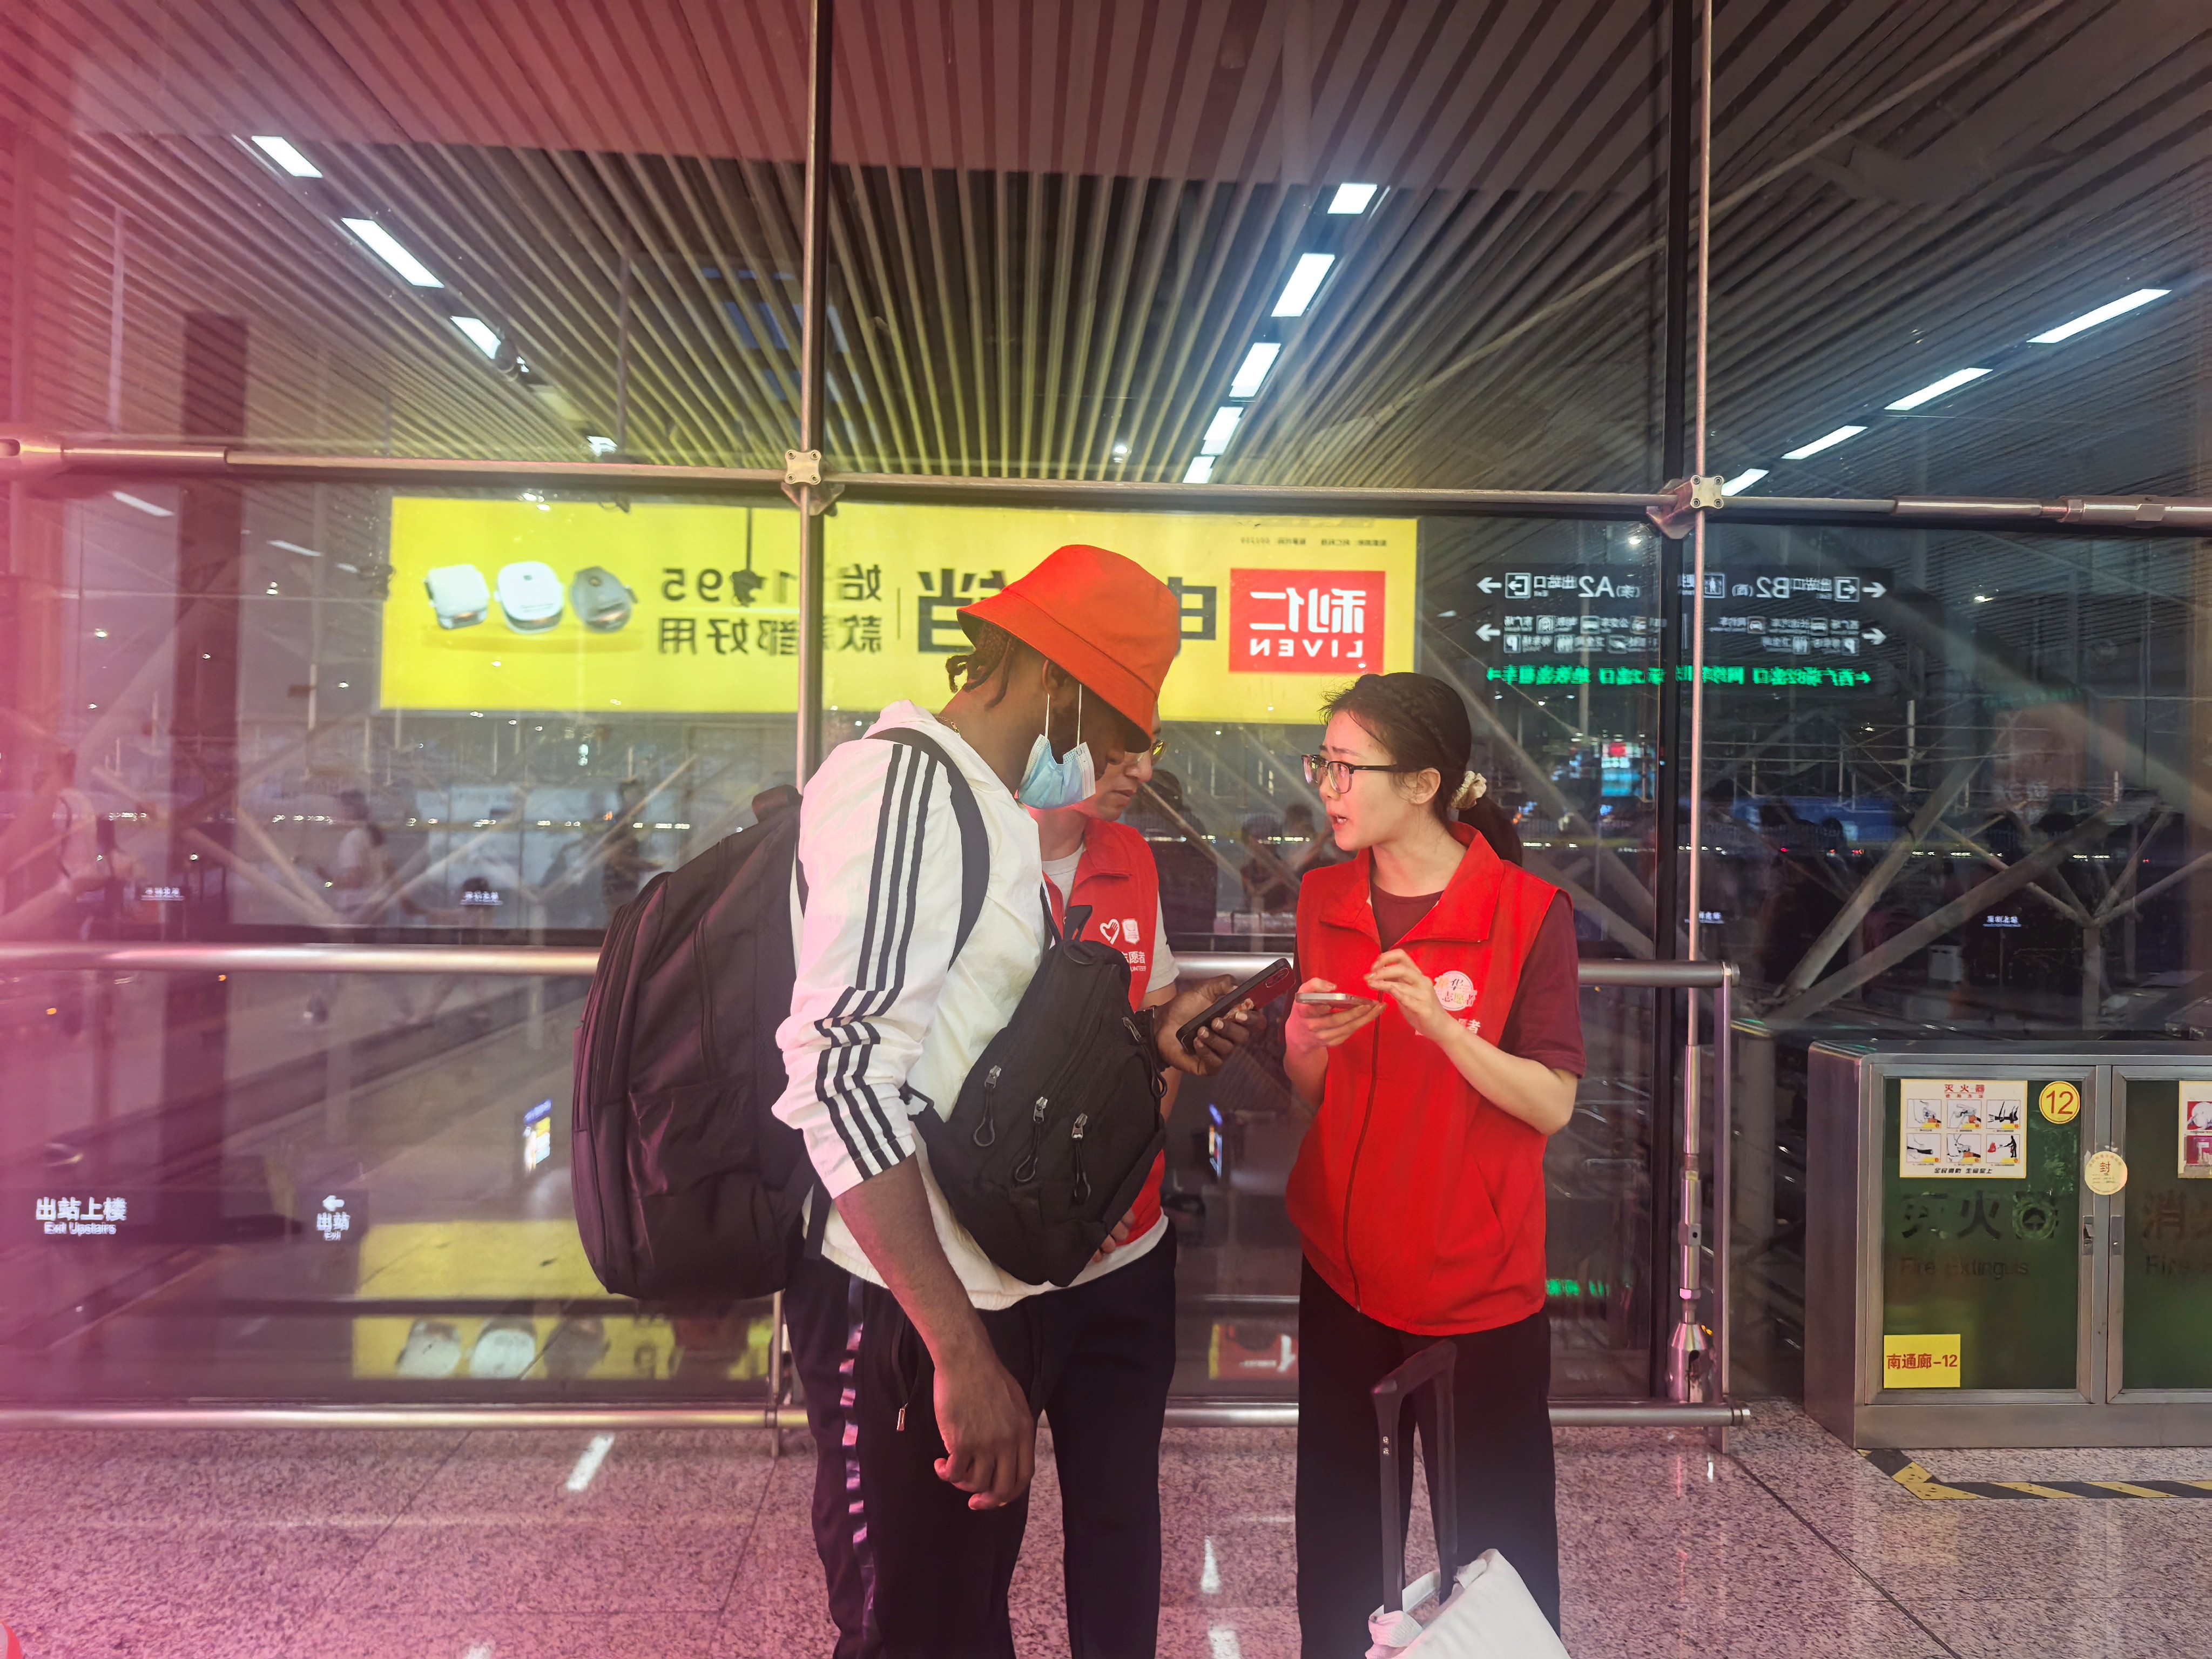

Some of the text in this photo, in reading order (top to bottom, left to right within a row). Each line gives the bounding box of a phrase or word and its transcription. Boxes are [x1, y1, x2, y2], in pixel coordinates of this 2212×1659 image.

[2045, 1089, 2075, 1115] 12
[2100, 1161, 2111, 1173] 封
[35, 1197, 127, 1221] 出站上楼
[316, 1212, 350, 1231] 出站
[1886, 1353, 1958, 1371] 南通廊-12
